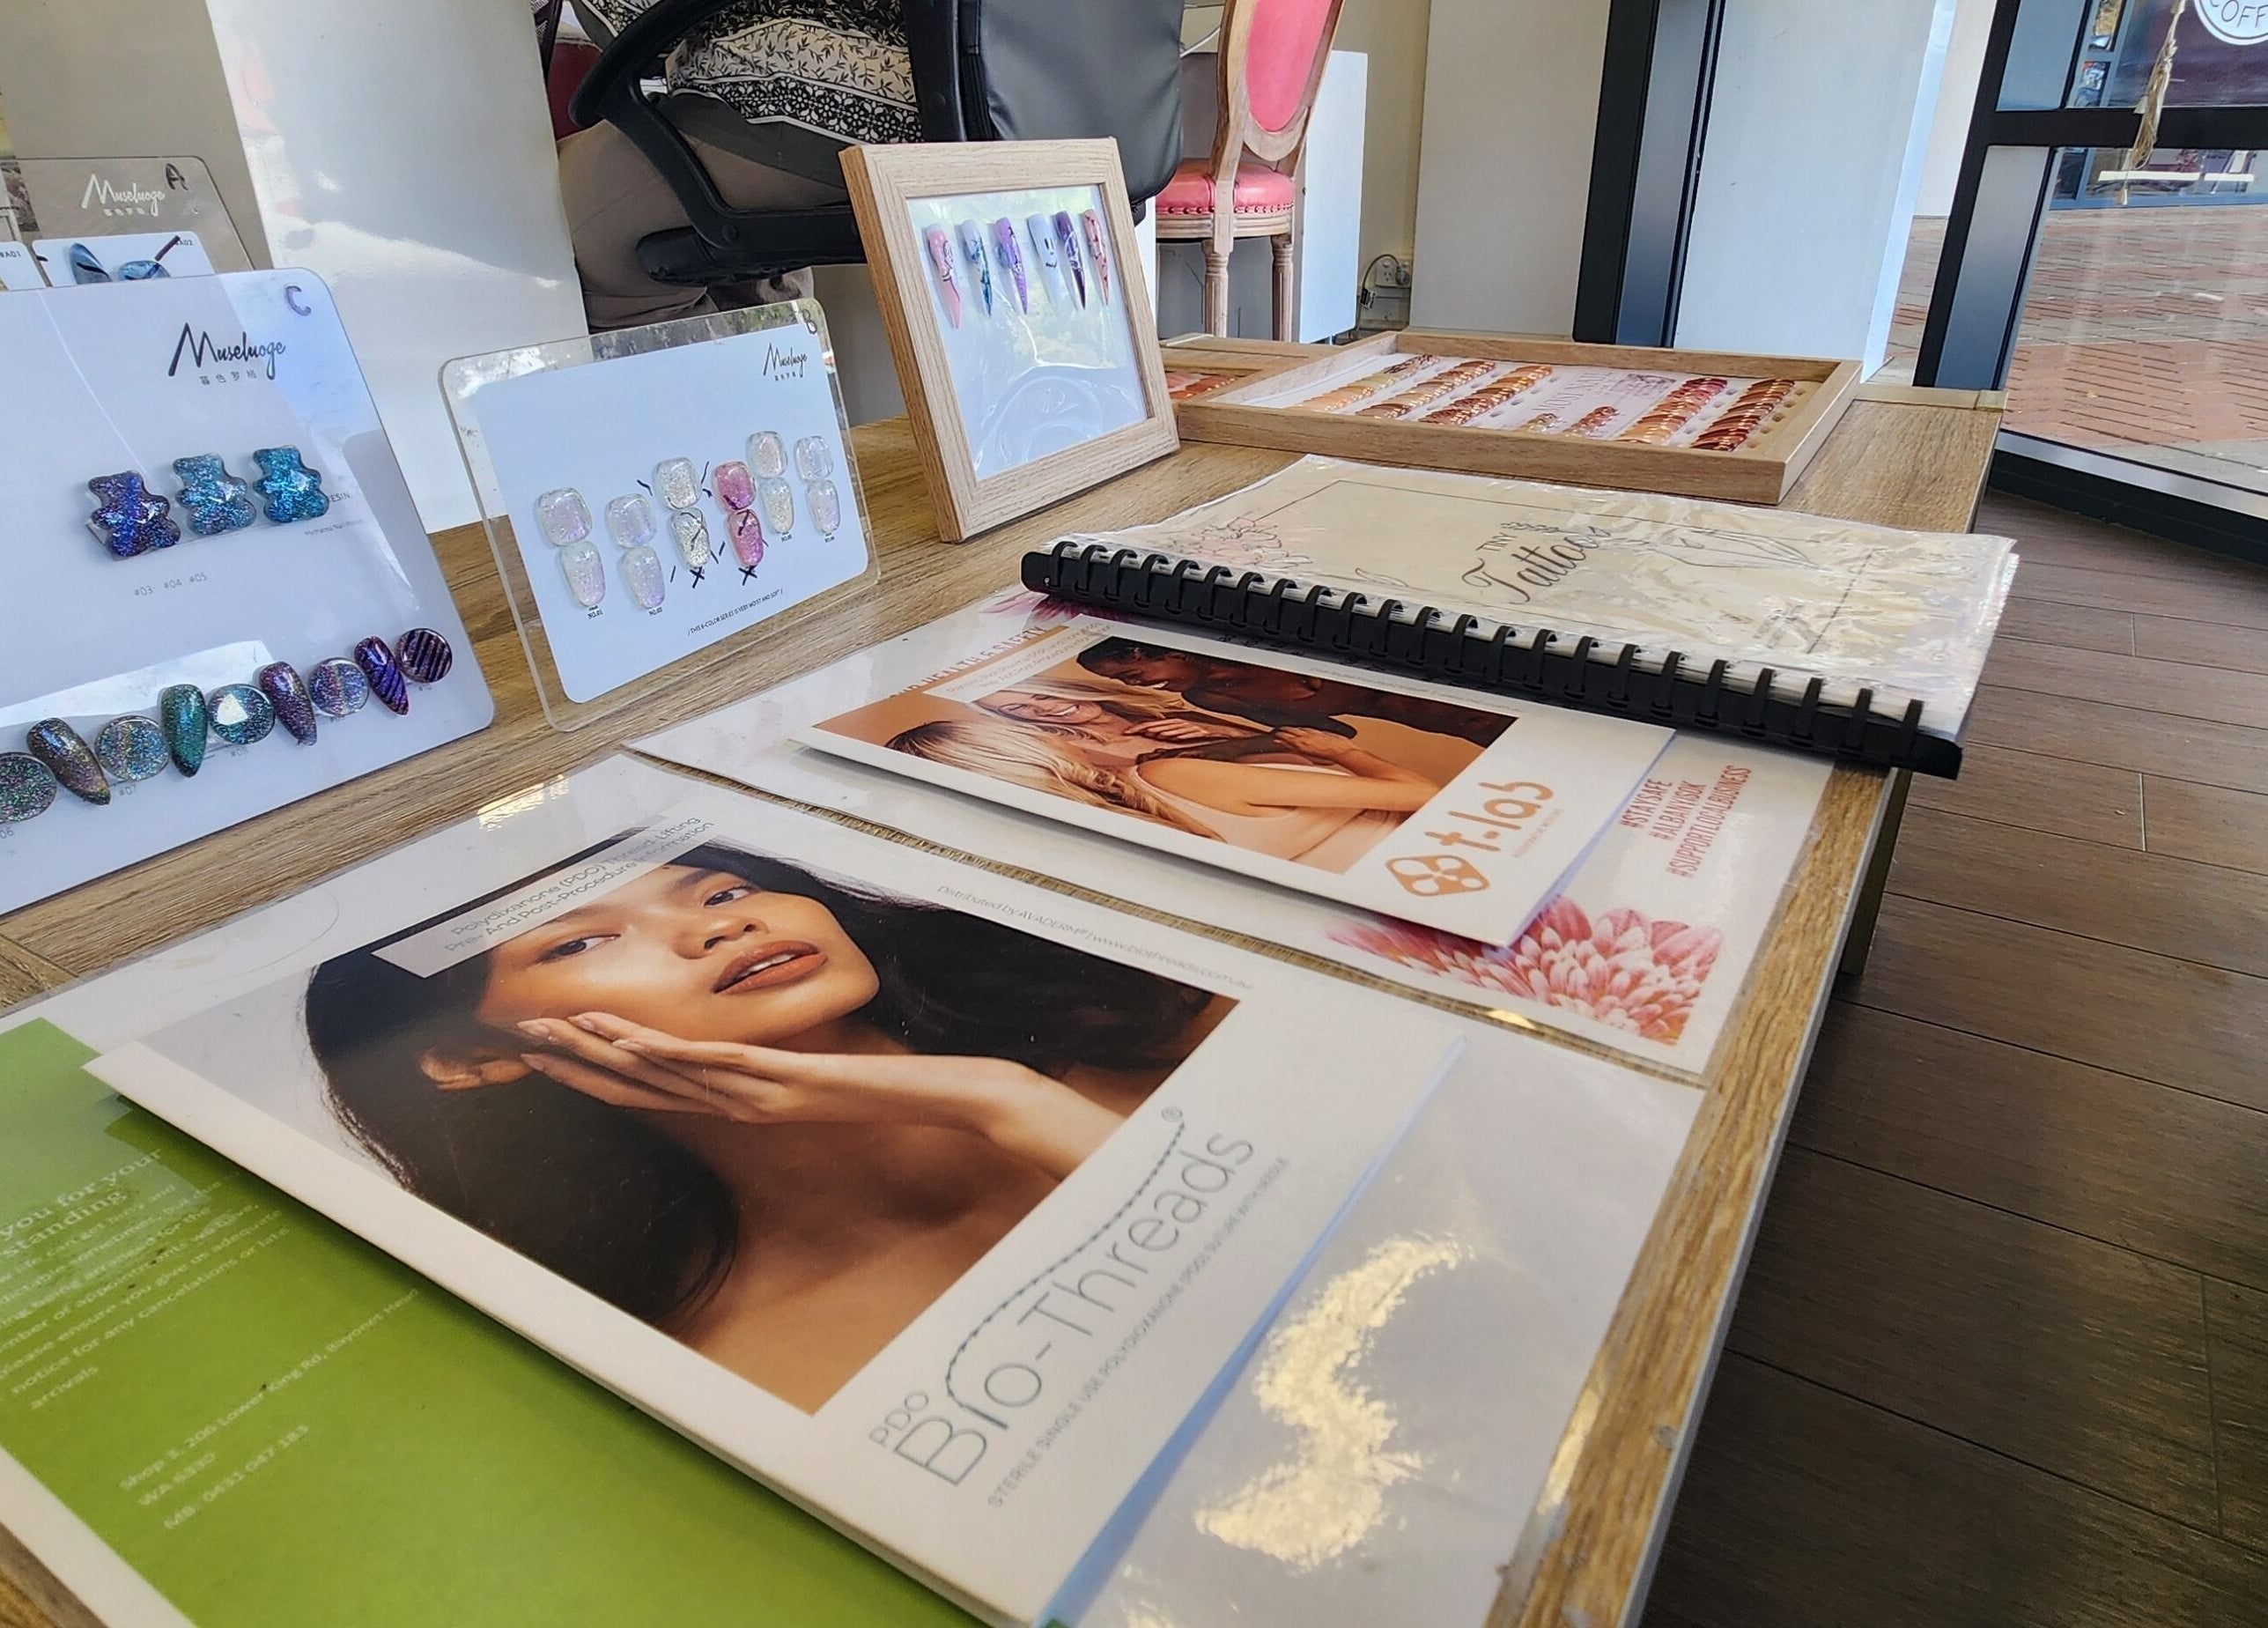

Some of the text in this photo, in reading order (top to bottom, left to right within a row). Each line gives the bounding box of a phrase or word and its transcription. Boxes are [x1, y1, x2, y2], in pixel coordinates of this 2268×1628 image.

[284, 285, 313, 317] C
[1619, 778, 1673, 830] #STAYSAFE
[55, 1180, 97, 1207] for
[101, 1149, 162, 1186] your
[868, 1391, 929, 1449] PDO
